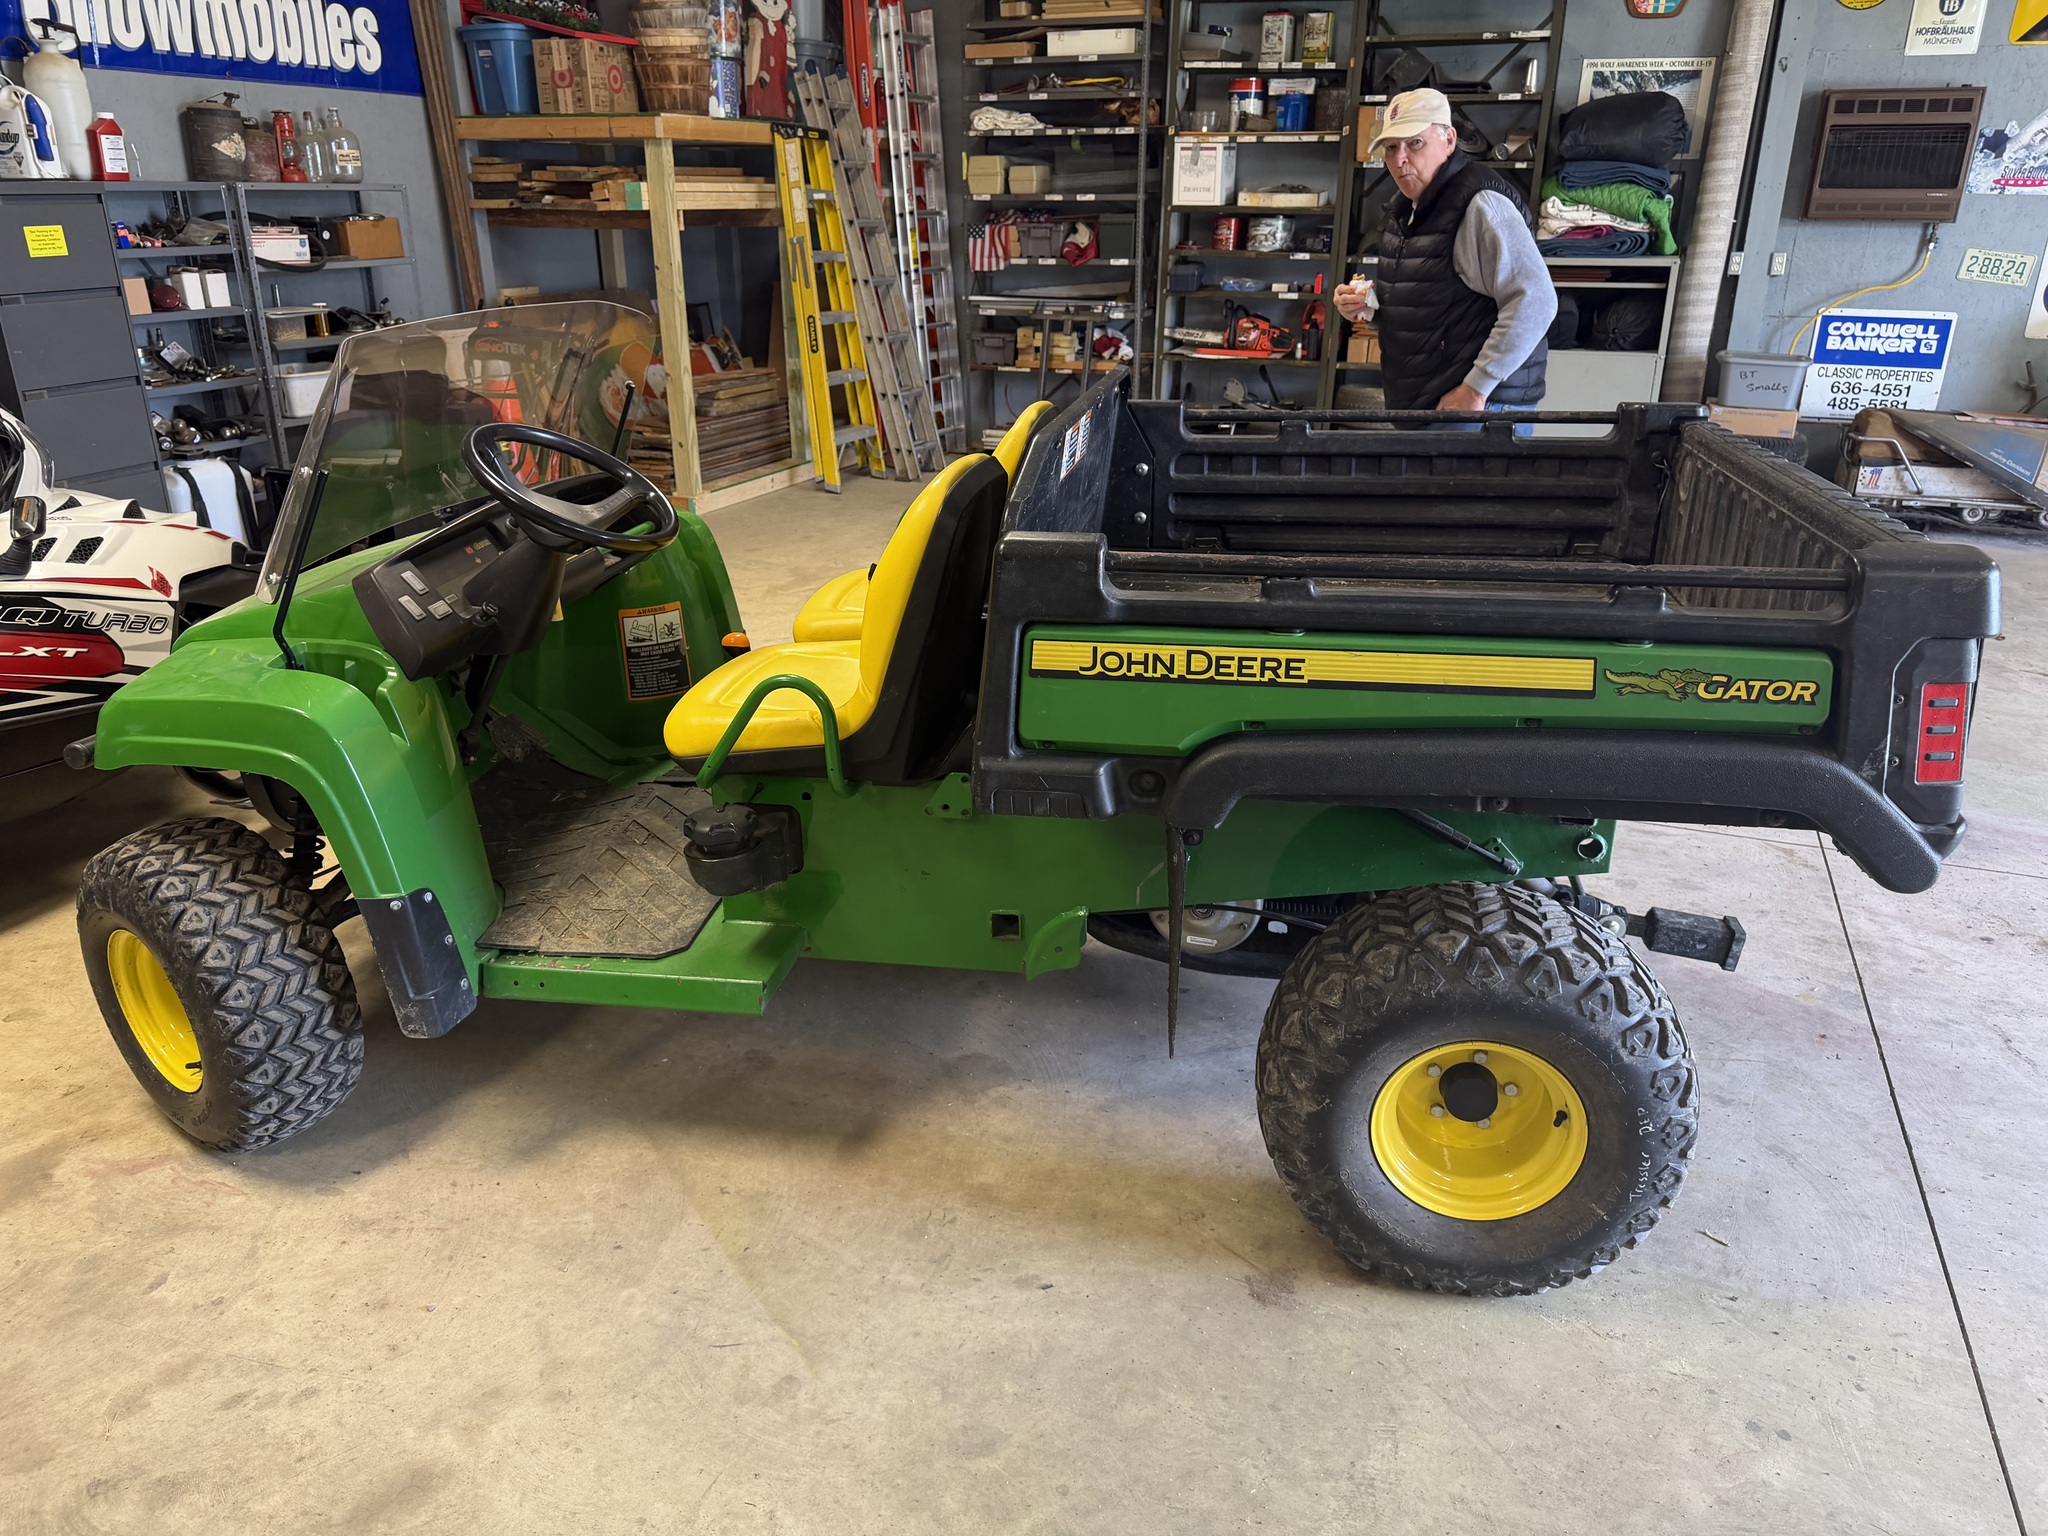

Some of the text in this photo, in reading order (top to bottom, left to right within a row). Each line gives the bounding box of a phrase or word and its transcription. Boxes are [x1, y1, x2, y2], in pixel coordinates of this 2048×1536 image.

[1915, 25, 1975, 36] HOFBRÄUHAUS
[1923, 37, 1962, 45] MÜNCHEN
[808, 317, 818, 351] STANLEY
[1740, 370, 1759, 380] BT
[1818, 366, 1934, 382] CLASSIC PROPERTIES
[1830, 381, 1911, 397] 636-4551
[1827, 397, 1908, 410] 485-5581
[641, 606, 666, 615] WARNING
[64, 609, 169, 633] TURBO
[1078, 645, 1306, 680] JOHN DEERE
[1697, 675, 1818, 703] GATOR
